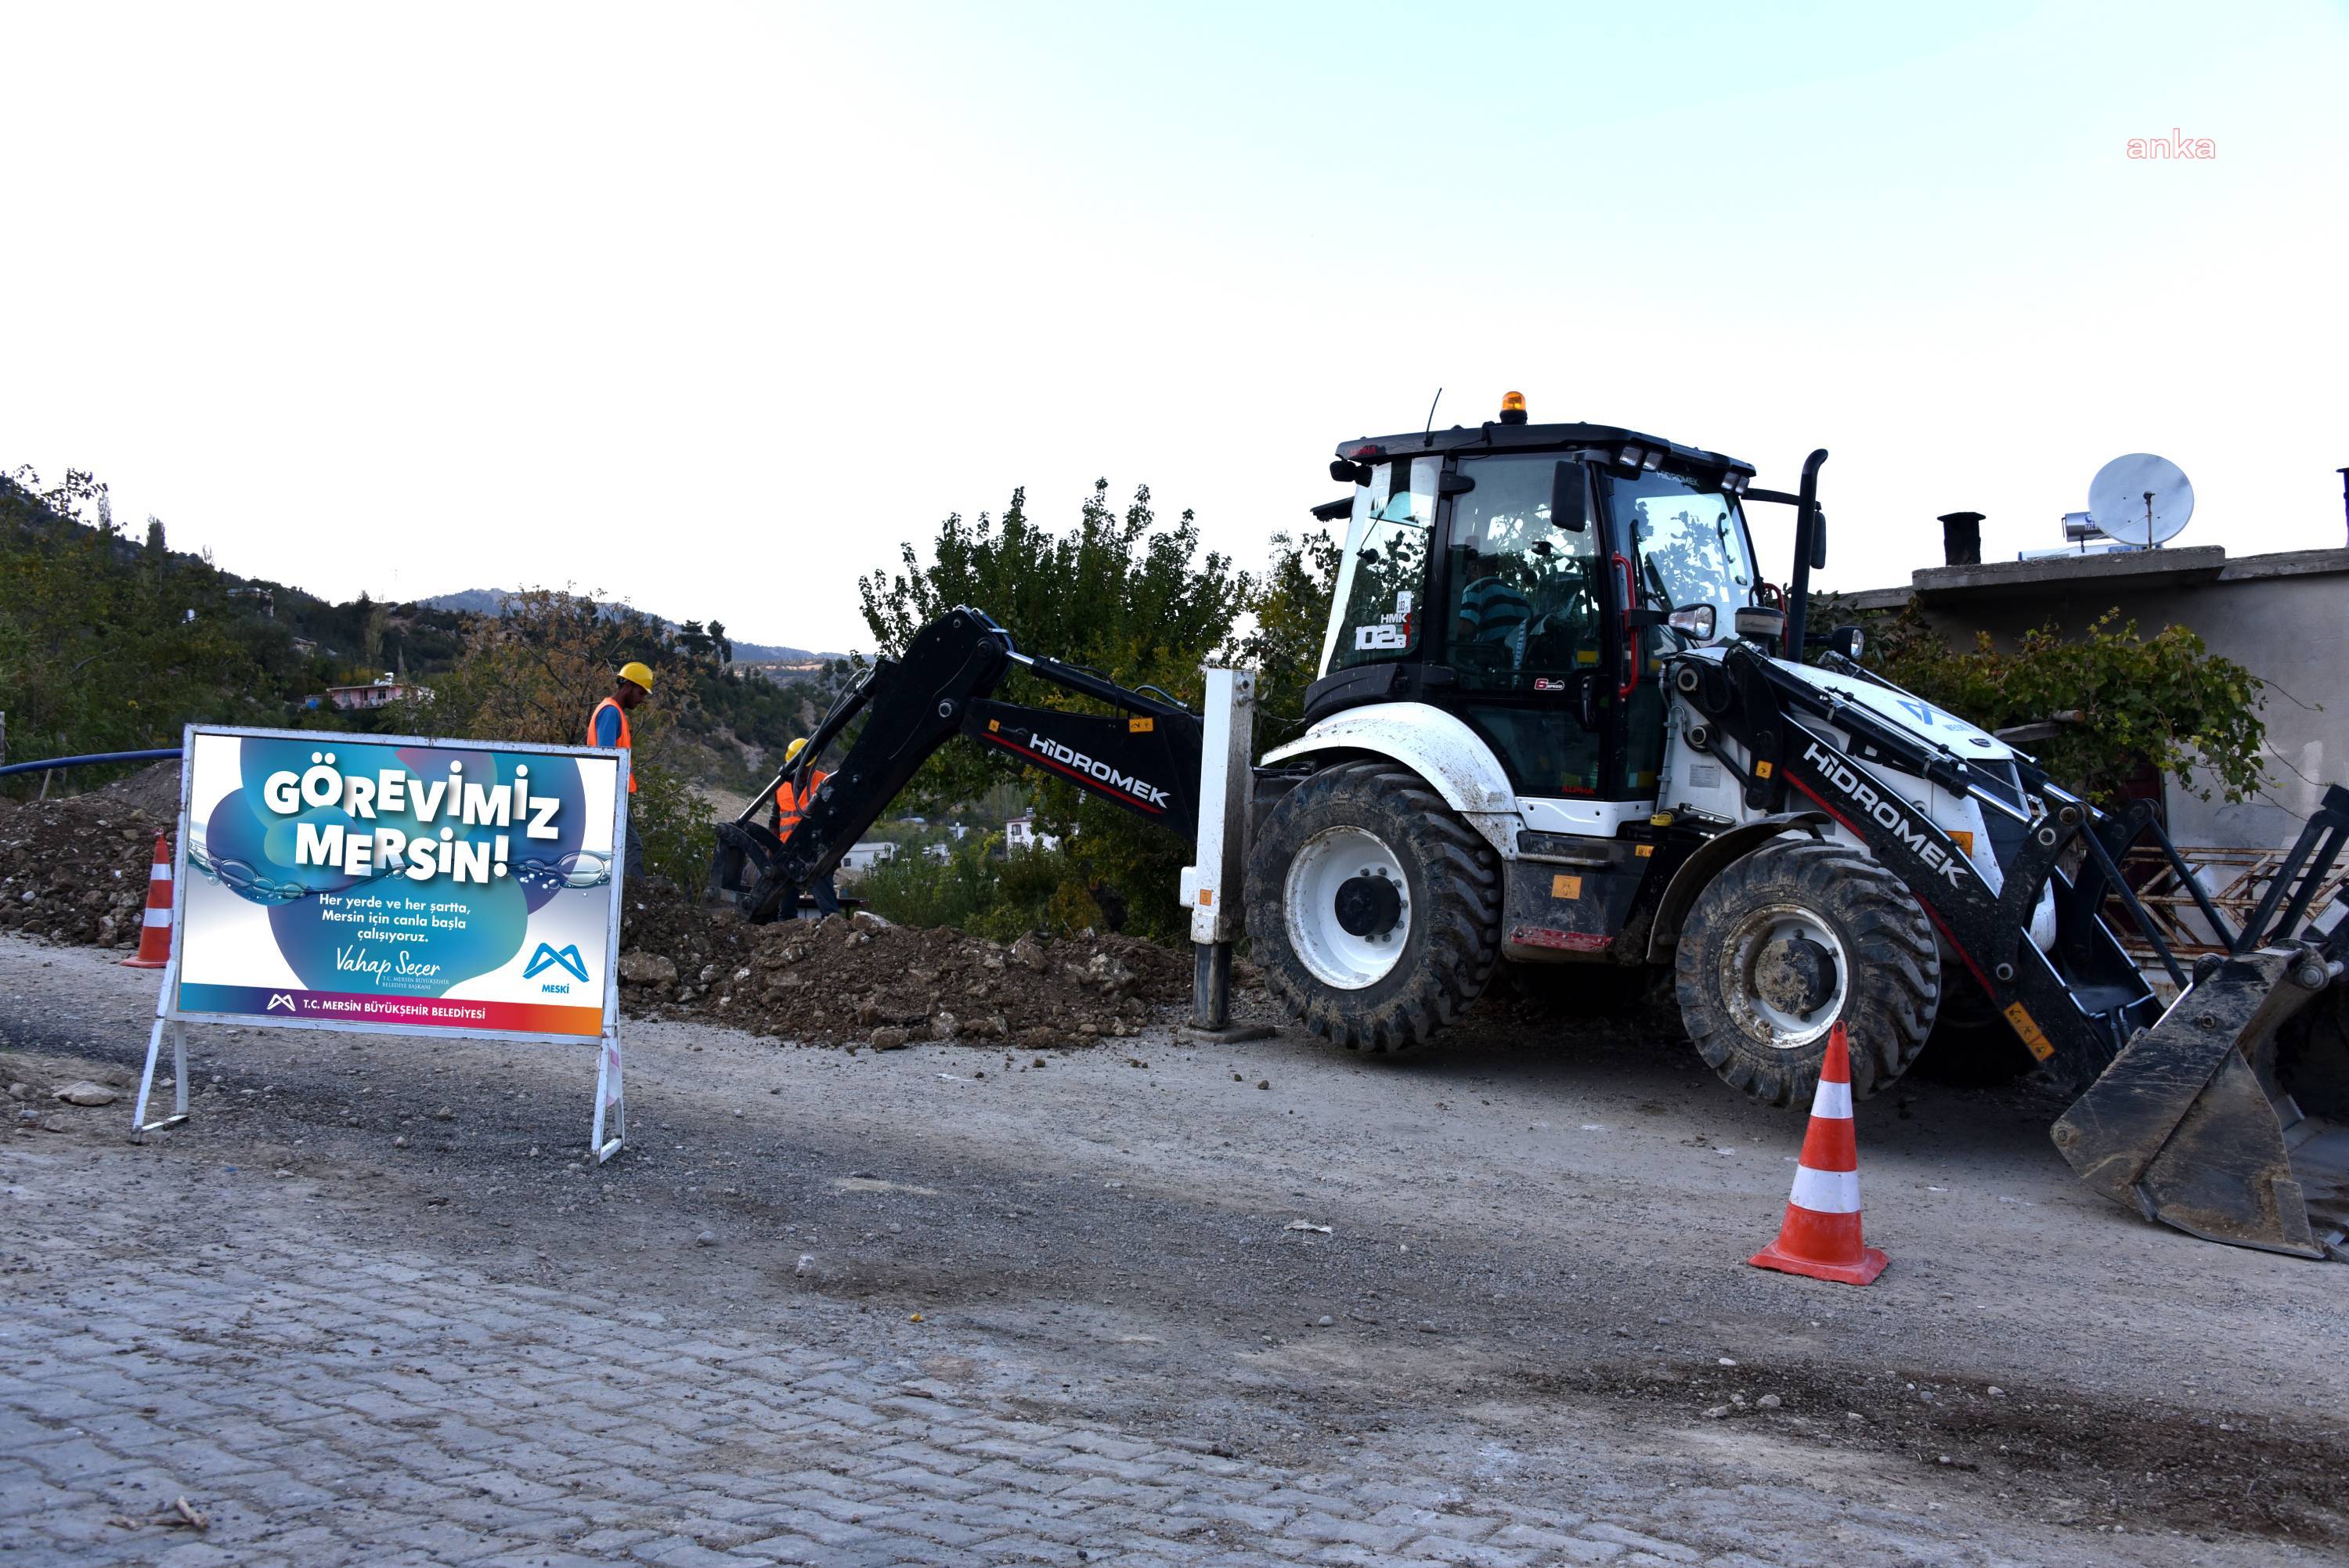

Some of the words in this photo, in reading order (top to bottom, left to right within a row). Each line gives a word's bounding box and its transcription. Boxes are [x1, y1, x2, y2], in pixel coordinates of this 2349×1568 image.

[1380, 613, 1407, 623] HMK
[264, 752, 560, 840] GÖREVİMİZ
[295, 823, 509, 884] MERSİN!
[319, 894, 341, 905] Her
[346, 896, 382, 909] yerde
[386, 900, 401, 909] ve
[405, 898, 426, 910] her
[430, 903, 471, 915] şartta,
[322, 910, 364, 923] Mersin
[369, 912, 389, 926] için
[393, 914, 428, 927] canla
[431, 915, 466, 931] başla
[357, 928, 428, 943] çalışıyoruz.
[337, 944, 392, 986] Vahap
[395, 950, 440, 976] Seçer
[542, 983, 569, 993] MESKİ
[303, 1000, 320, 1009] T.C.
[323, 1000, 361, 1011] MERSİN
[365, 1001, 428, 1017] BÜYÜKŞEHİR
[431, 1006, 485, 1019] BELEDİYESİ
